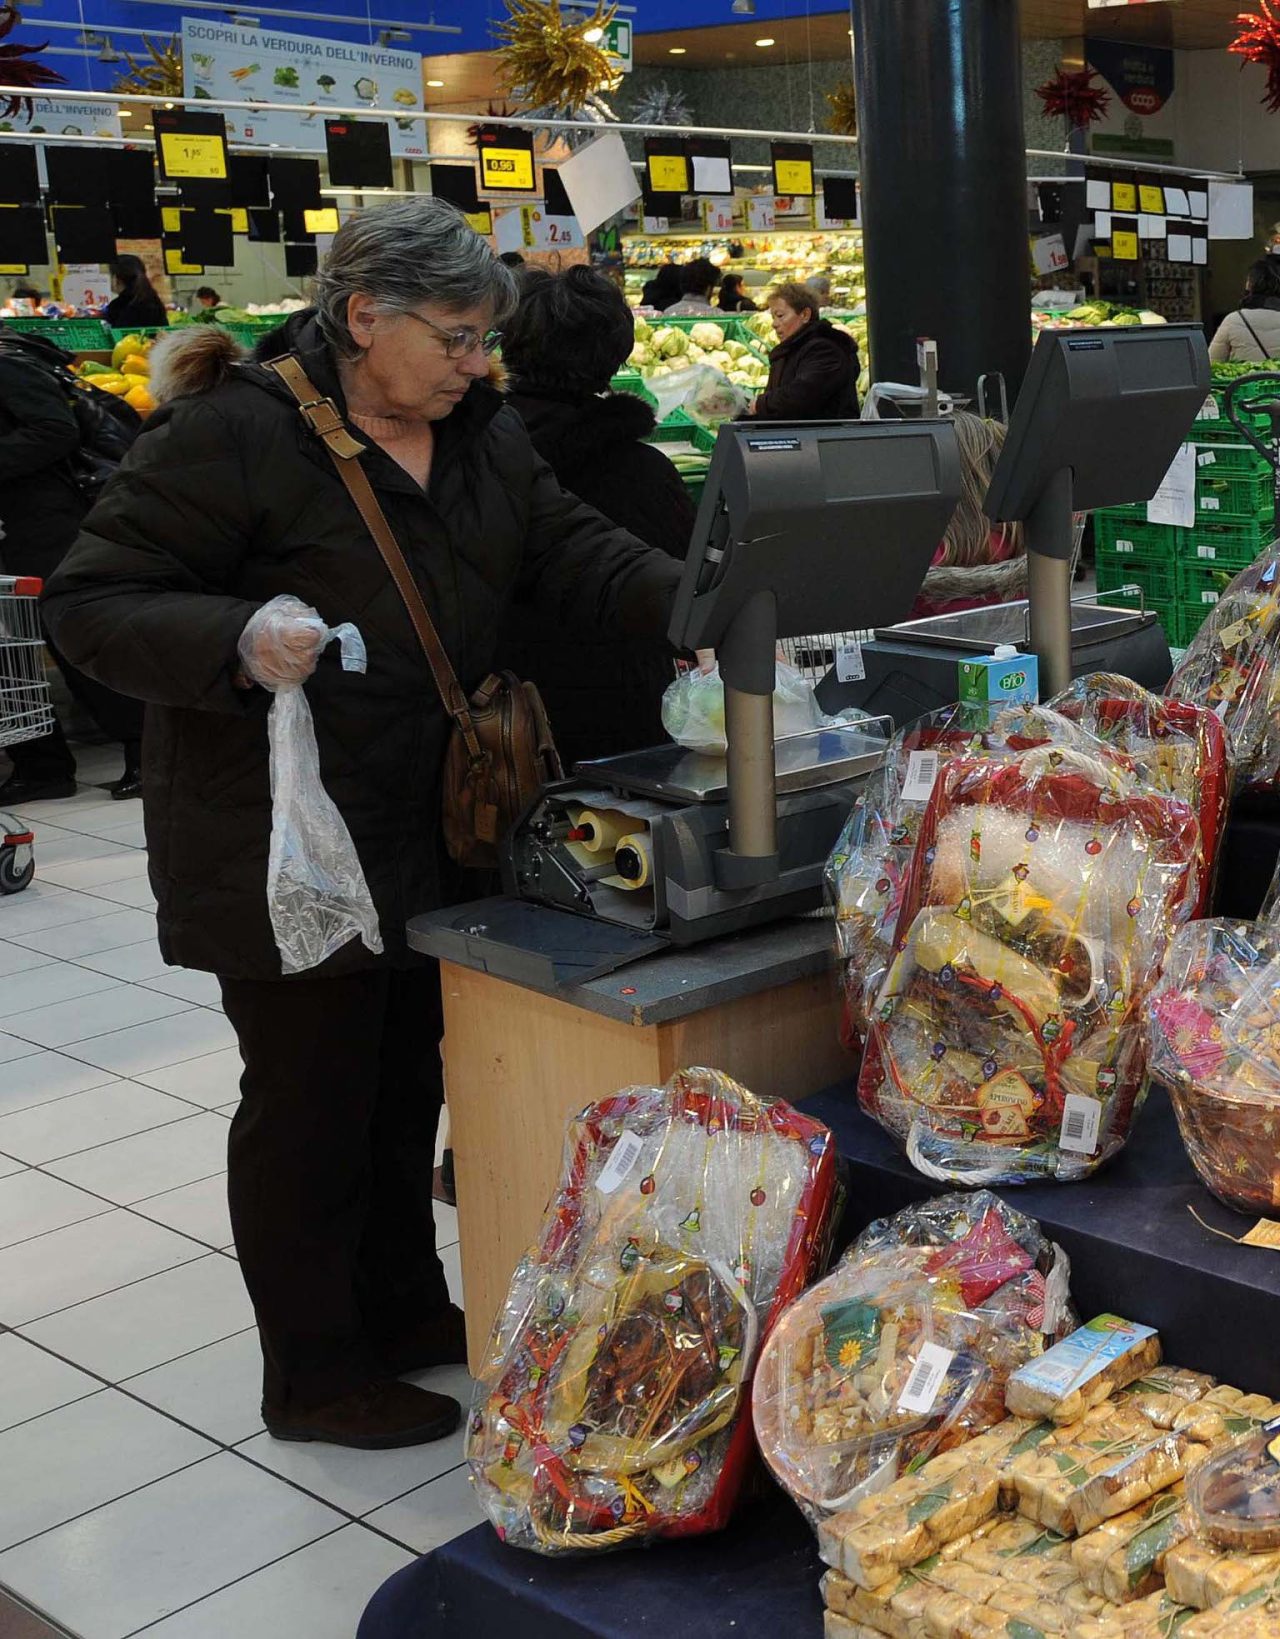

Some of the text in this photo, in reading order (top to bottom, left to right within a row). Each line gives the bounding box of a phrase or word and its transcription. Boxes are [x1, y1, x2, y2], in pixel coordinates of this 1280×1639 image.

[187, 25, 237, 45] SCOPRI
[241, 32, 258, 46] LA
[262, 37, 322, 57] VERDURA
